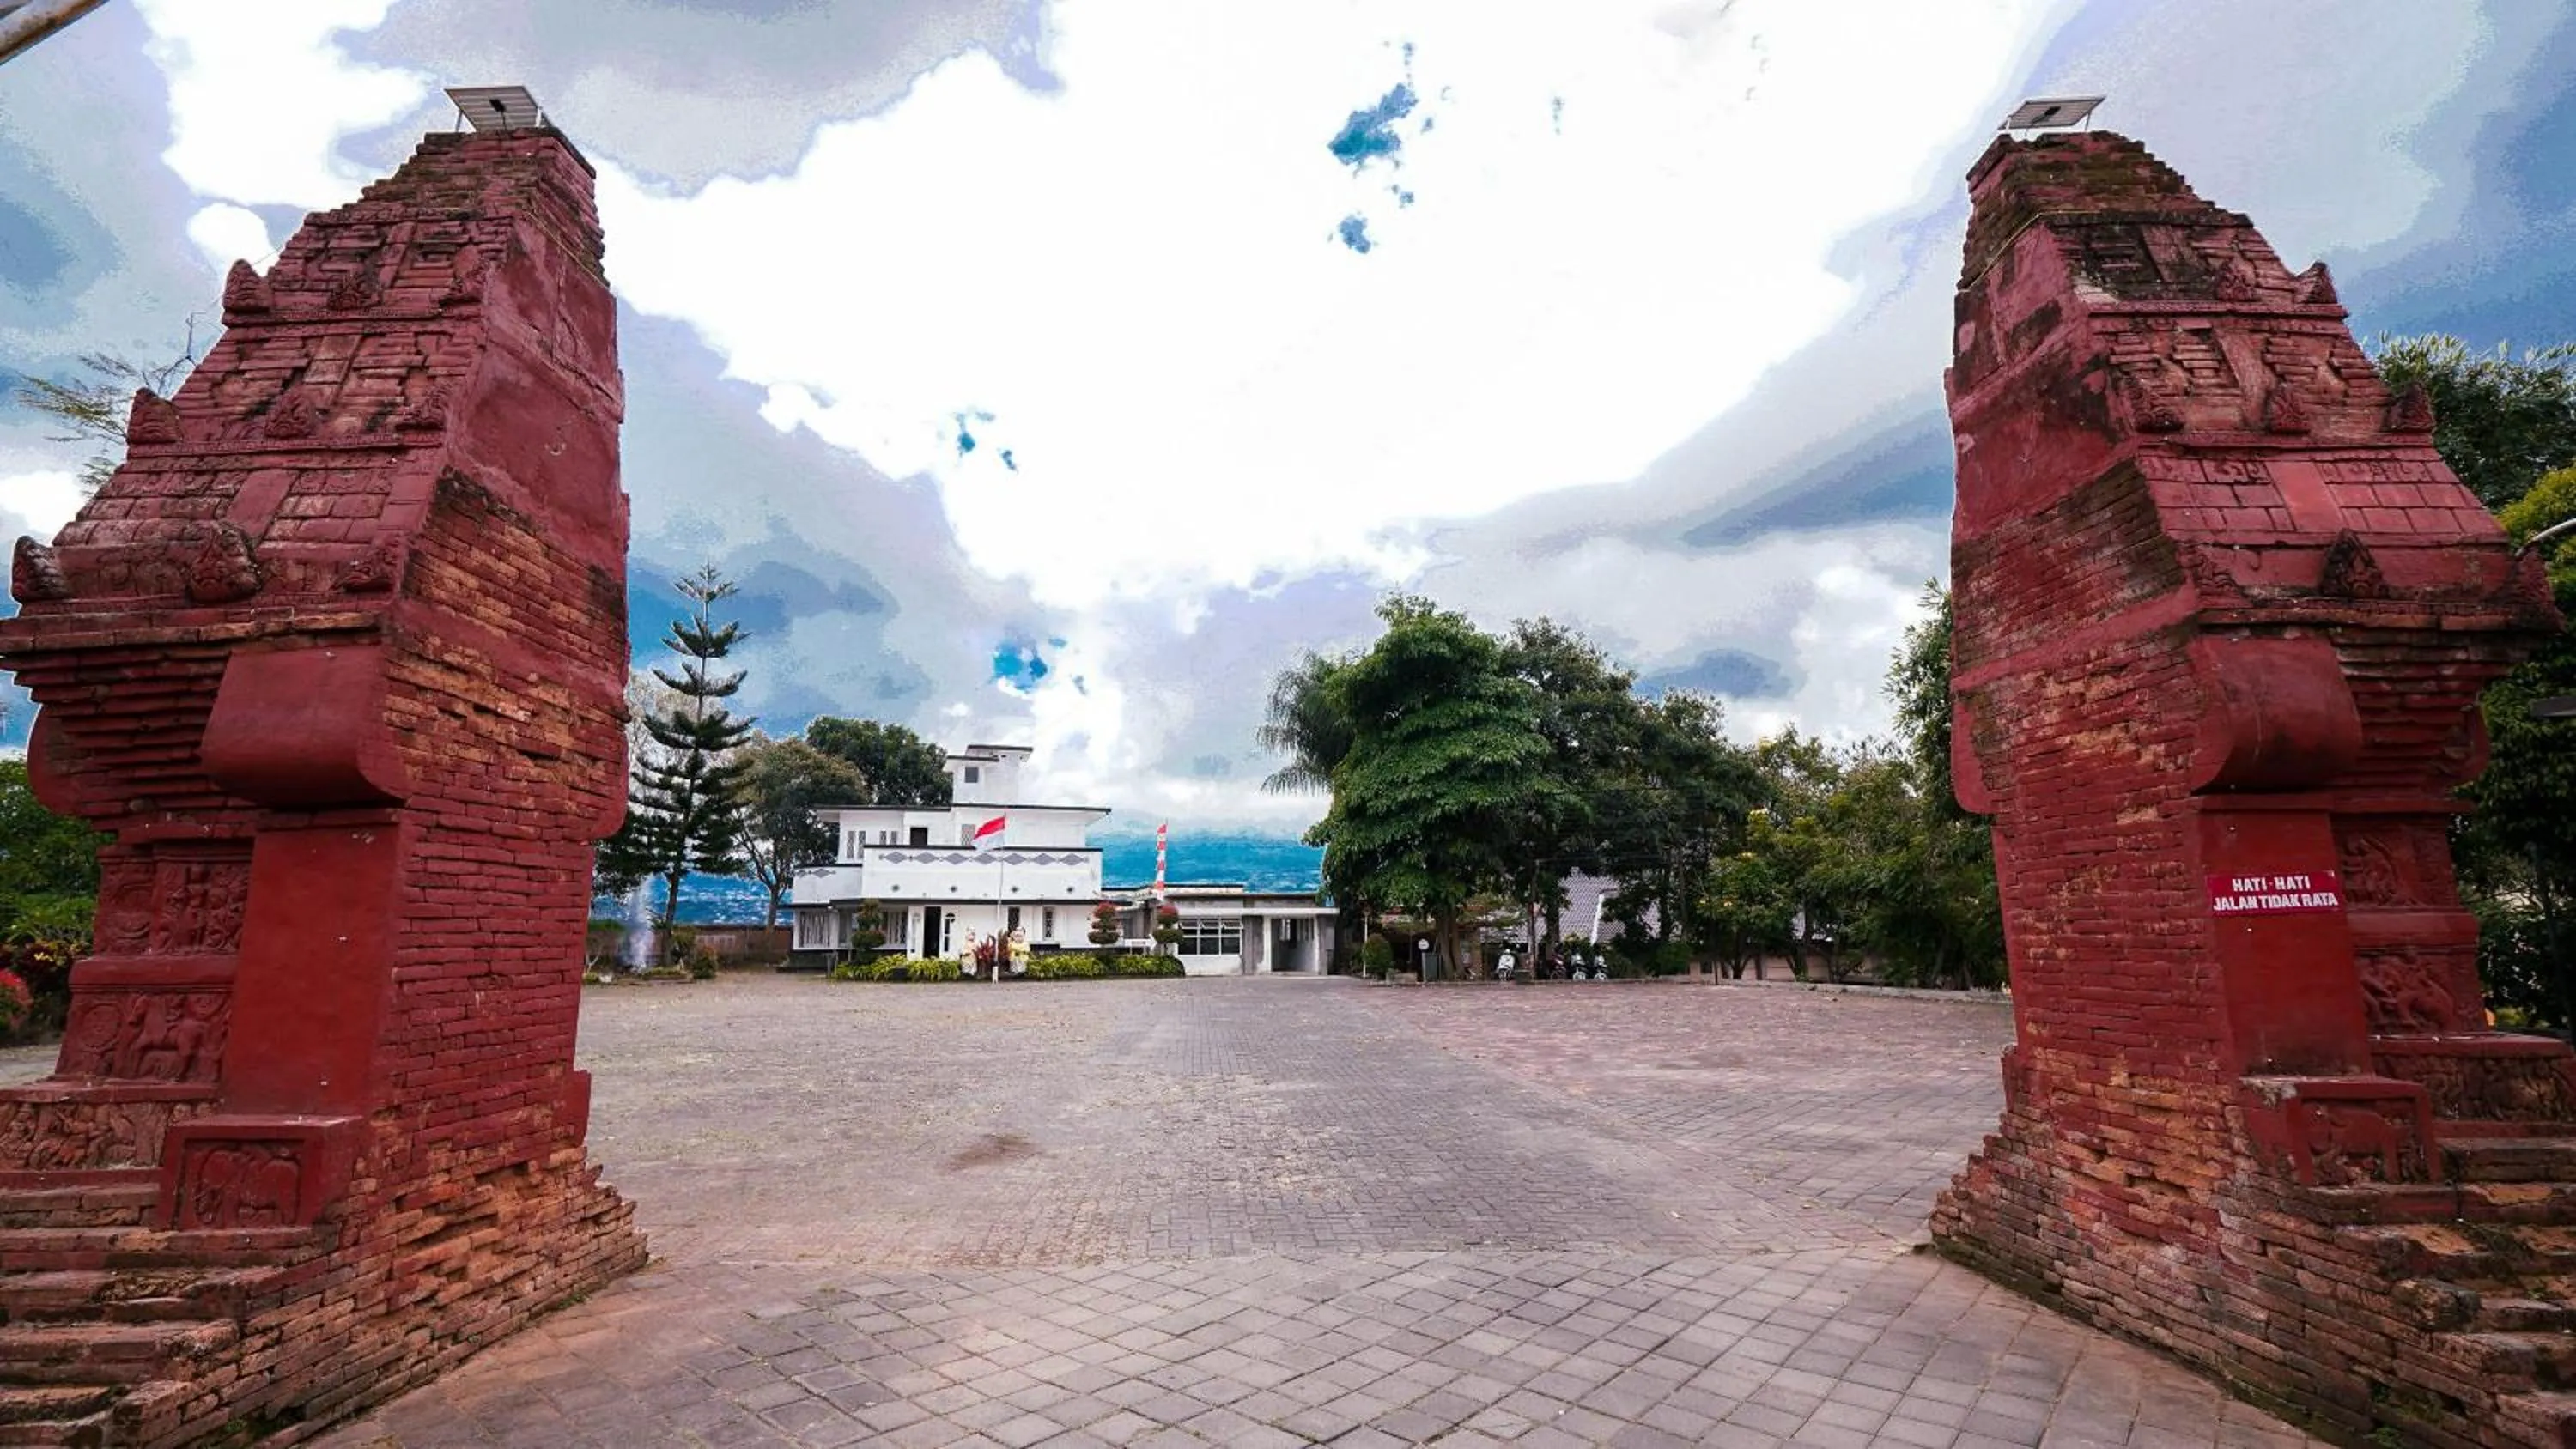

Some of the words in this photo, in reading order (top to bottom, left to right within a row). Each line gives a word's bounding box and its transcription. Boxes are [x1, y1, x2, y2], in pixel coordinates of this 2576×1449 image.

[2213, 896, 2258, 911] JALAN
[2258, 894, 2301, 909] TIDAK
[2301, 892, 2339, 907] RATA
